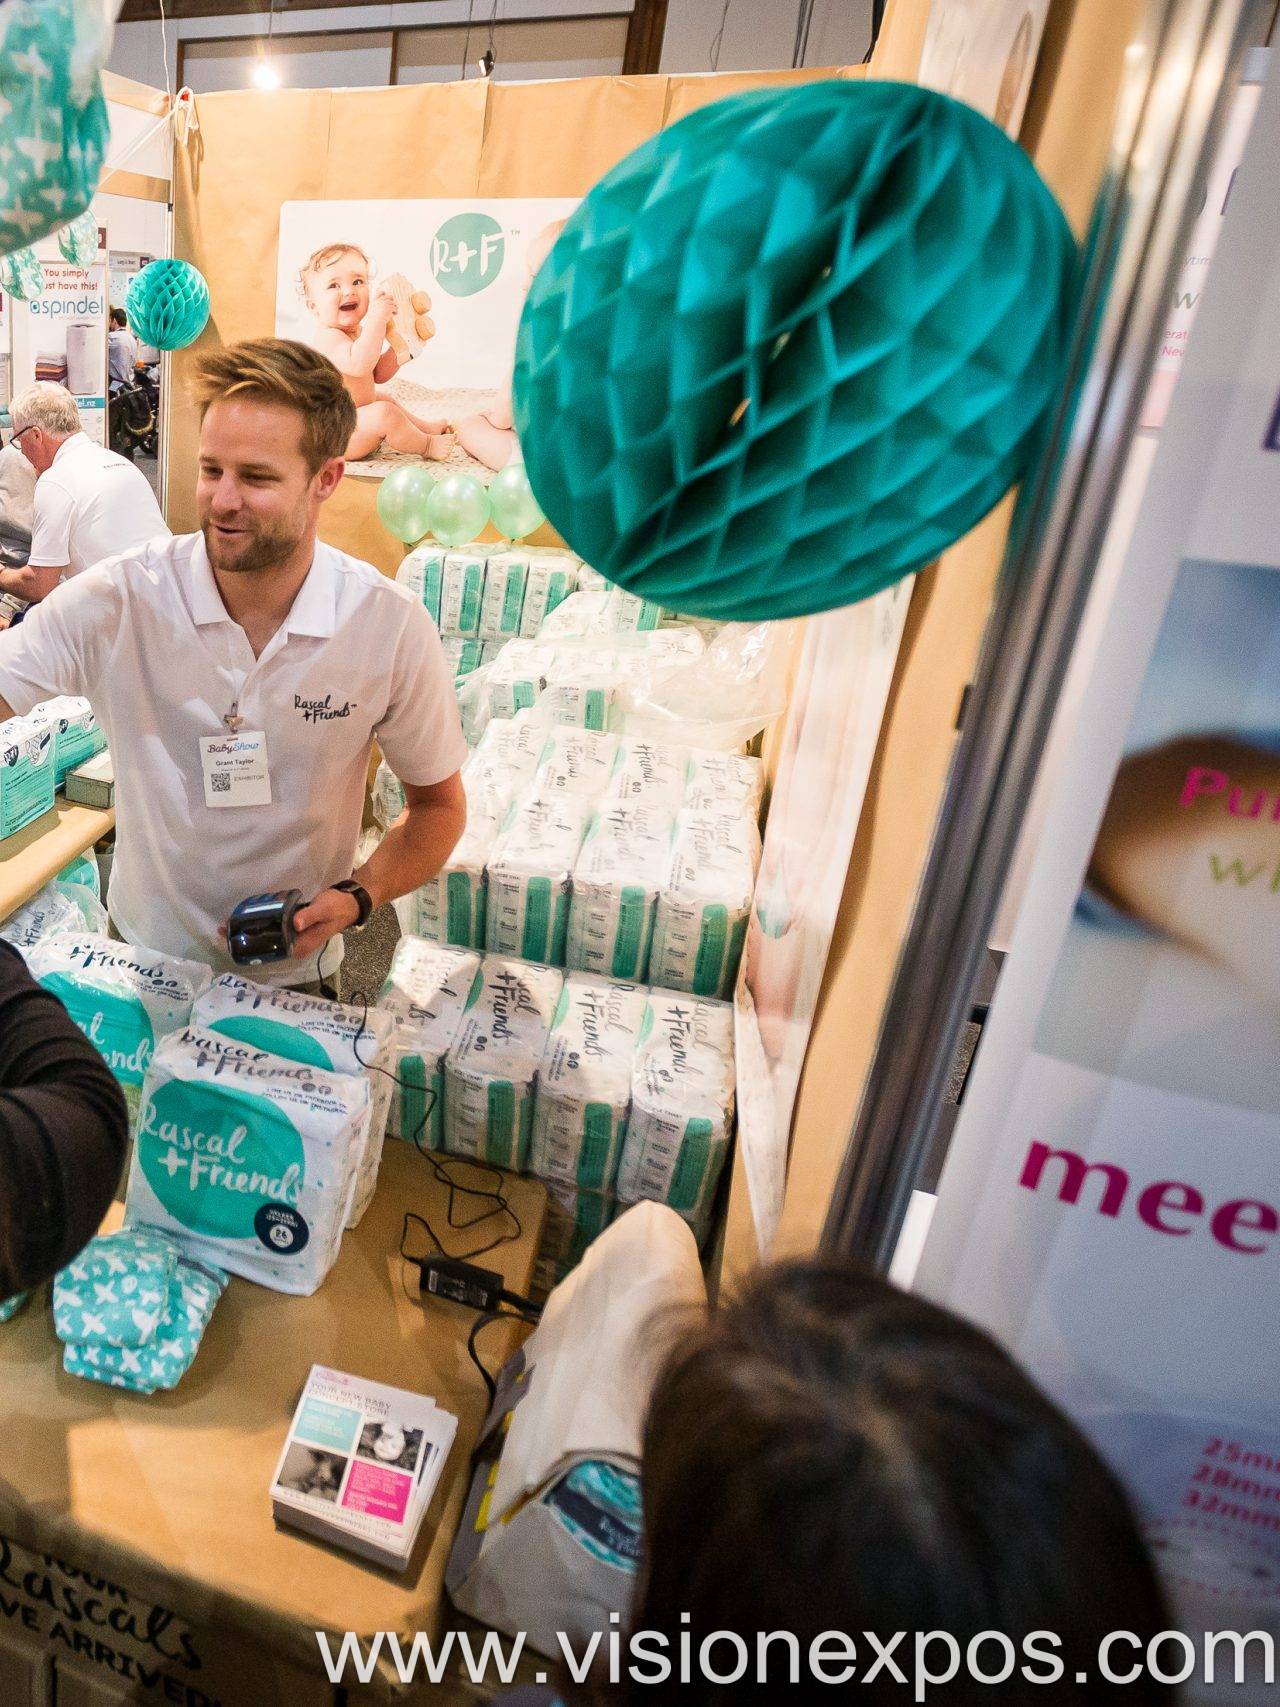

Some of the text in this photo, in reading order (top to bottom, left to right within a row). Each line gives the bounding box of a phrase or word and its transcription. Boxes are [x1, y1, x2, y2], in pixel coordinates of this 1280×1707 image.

[433, 233, 508, 277] R+F
[44, 267, 89, 279] You simply
[60, 280, 79, 290] have
[81, 280, 98, 291] this!
[30, 296, 104, 319] aspindel
[294, 694, 332, 711] Rascal
[235, 758, 254, 767] Taylor
[576, 989, 613, 1057] +Friends
[140, 1102, 248, 1164] Rascal
[158, 1147, 302, 1205] +Friends
[365, 1398, 393, 1410] BABY
